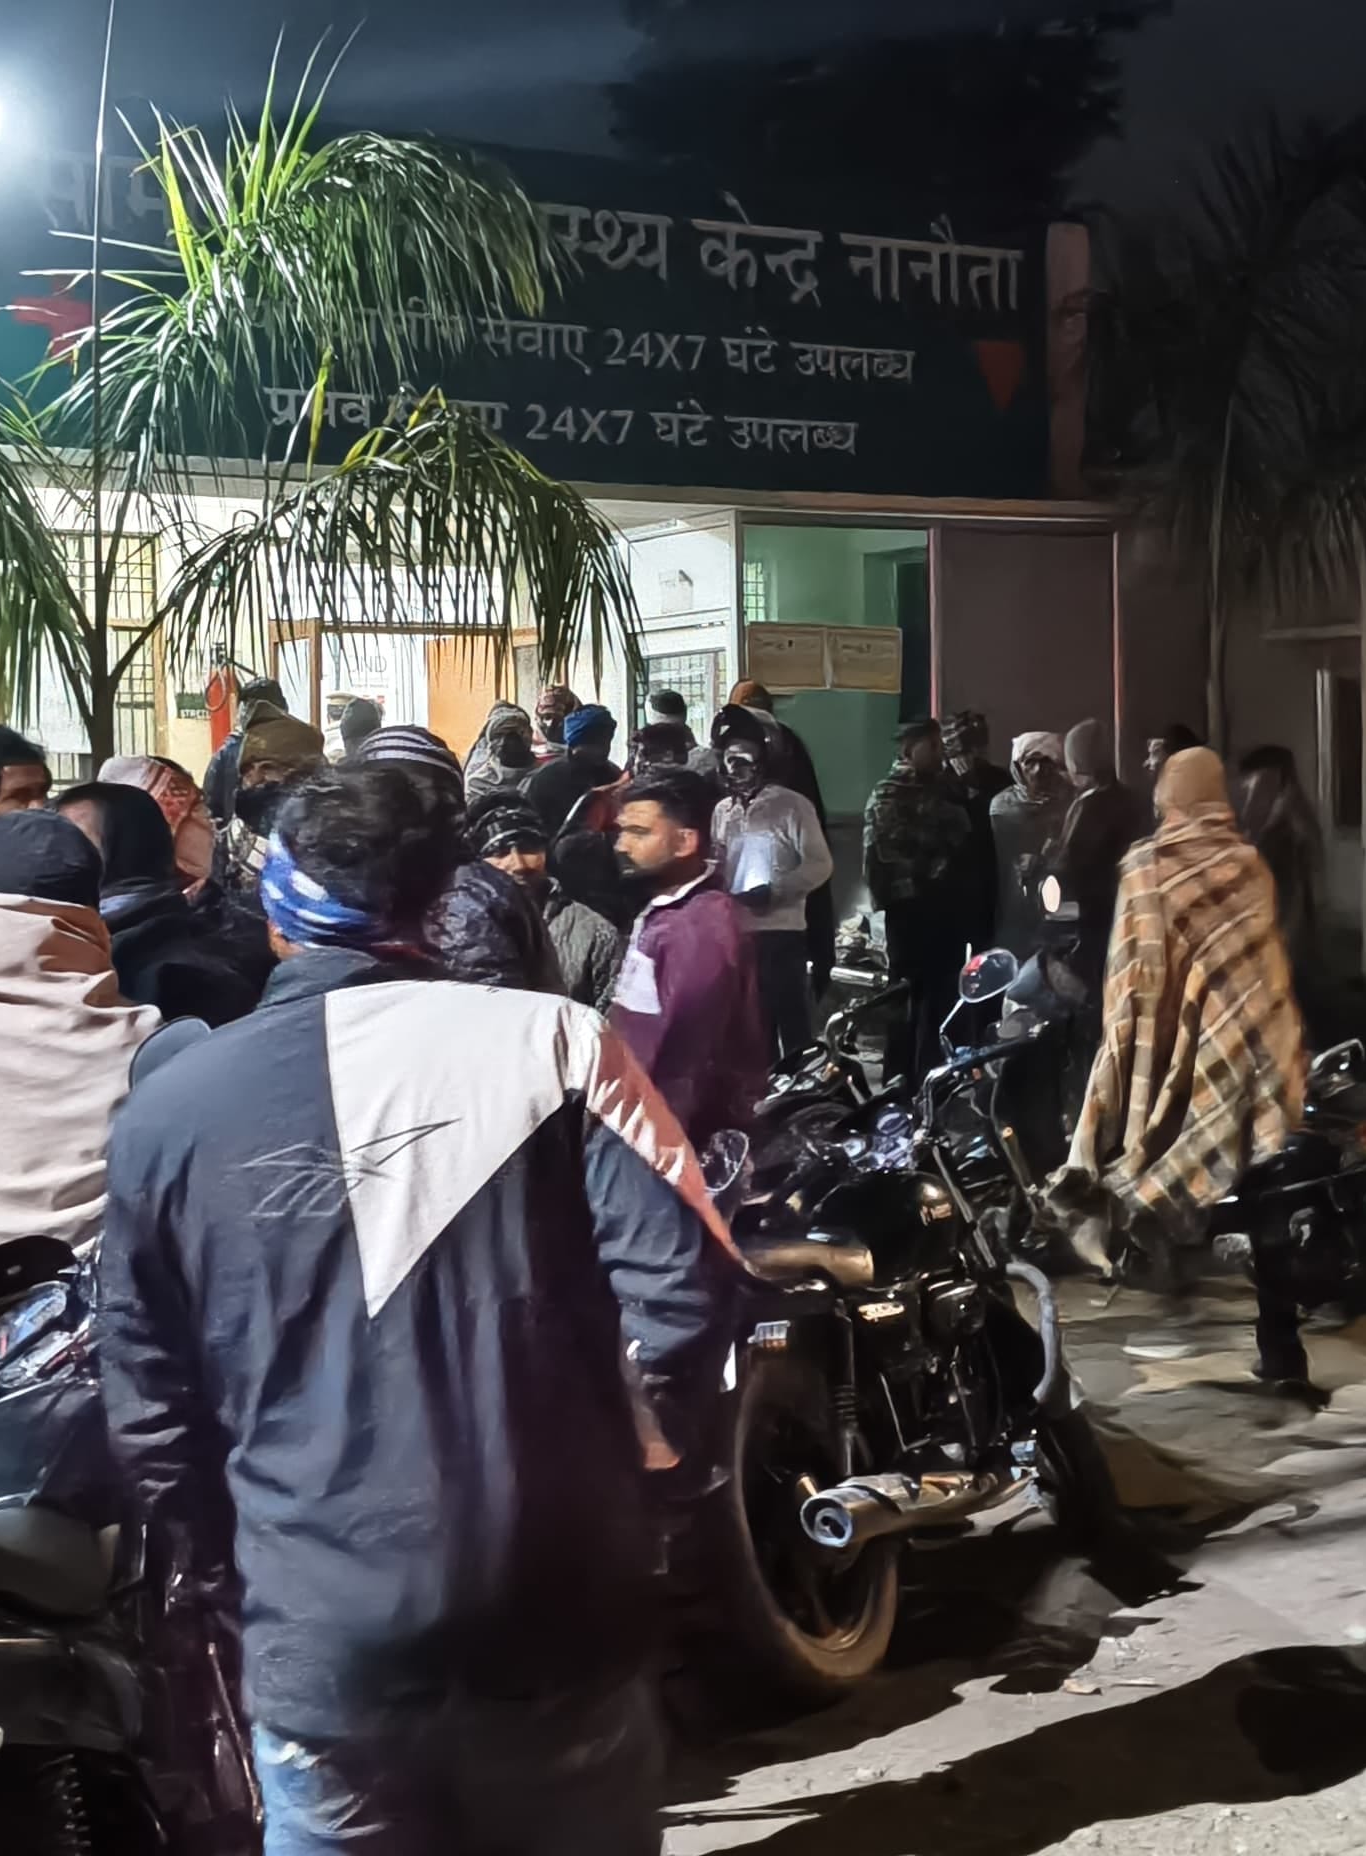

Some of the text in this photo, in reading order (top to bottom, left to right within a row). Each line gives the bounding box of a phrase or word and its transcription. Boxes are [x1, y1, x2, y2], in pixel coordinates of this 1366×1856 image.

[690, 191, 823, 307] केन्द्र
[839, 213, 1023, 310] नानौता
[603, 327, 707, 372] 24X7
[721, 325, 778, 373] घंटे
[789, 341, 915, 384] उपलब्ध
[526, 403, 634, 446] 24X7
[648, 399, 713, 446] घंटे
[723, 415, 859, 455] उपलब्ध
